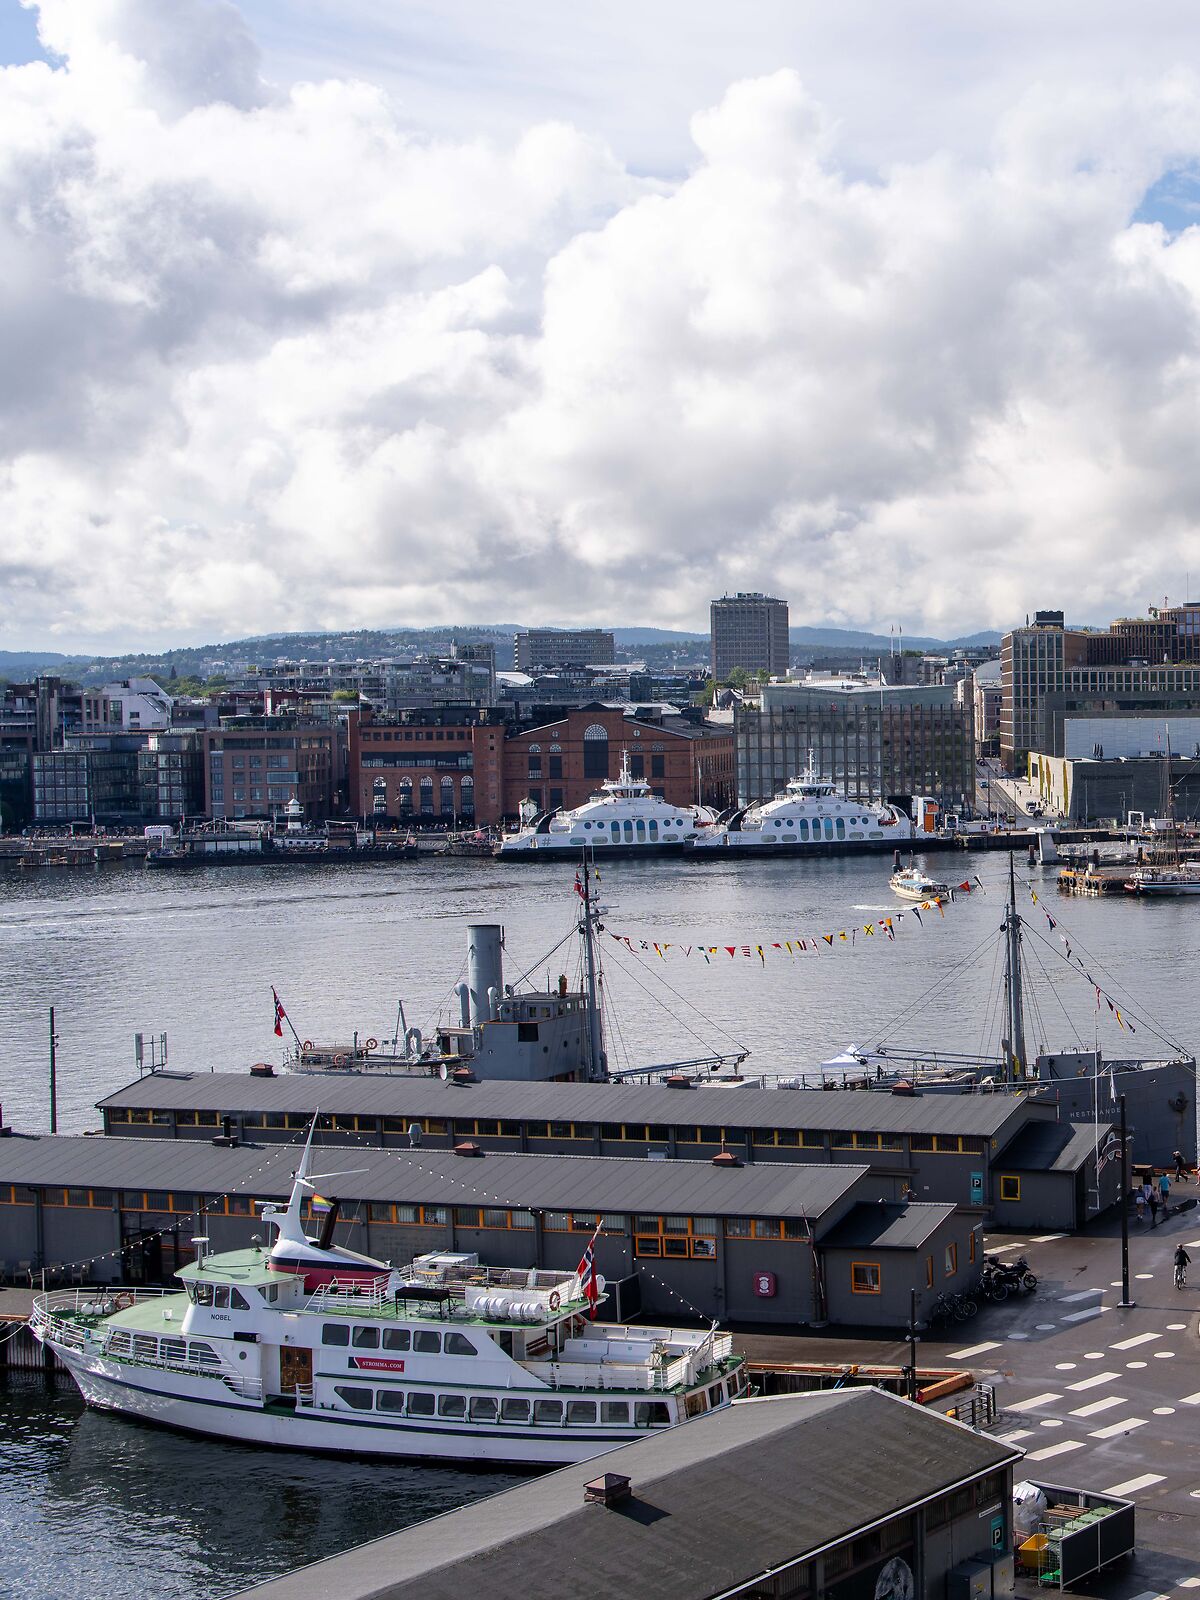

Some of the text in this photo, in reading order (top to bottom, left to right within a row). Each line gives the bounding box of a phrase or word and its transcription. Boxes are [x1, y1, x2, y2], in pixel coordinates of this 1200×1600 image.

[1070, 1107, 1127, 1118] HESTMANDE
[973, 1179, 981, 1187] P
[211, 1313, 232, 1321] NOBEL
[362, 1360, 402, 1369] STROMMA.COM
[994, 1528, 1001, 1544] P
